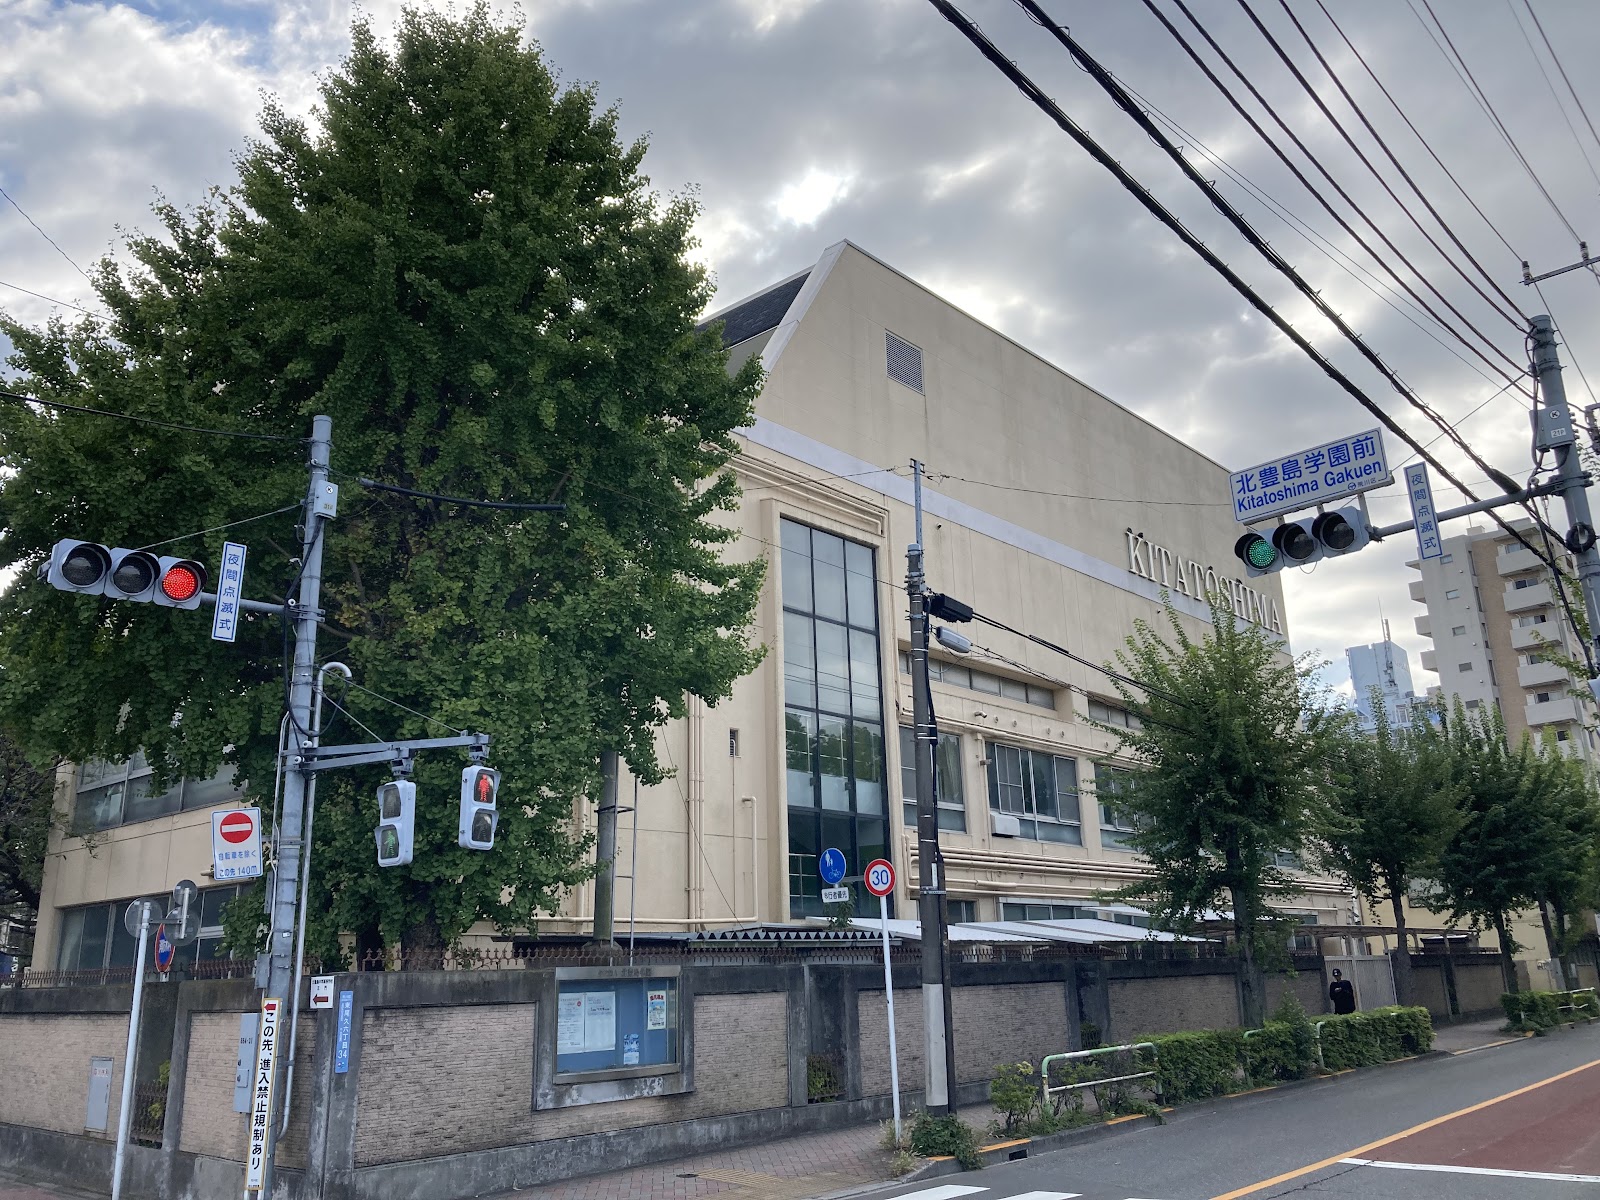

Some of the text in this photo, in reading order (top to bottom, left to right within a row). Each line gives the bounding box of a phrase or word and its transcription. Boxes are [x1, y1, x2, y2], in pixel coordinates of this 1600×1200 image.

[1235, 435, 1376, 495] 北豊島学園前
[1237, 460, 1382, 513] Kitatoshima Gakuen
[1411, 473, 1437, 550] 夜間点滅式
[218, 553, 241, 631] 夜間点滅式
[1125, 530, 1284, 636] KITATOSHIMA
[218, 849, 257, 861] 自転車を除く
[872, 869, 889, 886] 30
[251, 1012, 275, 1170] この先、進入禁止規制あり
